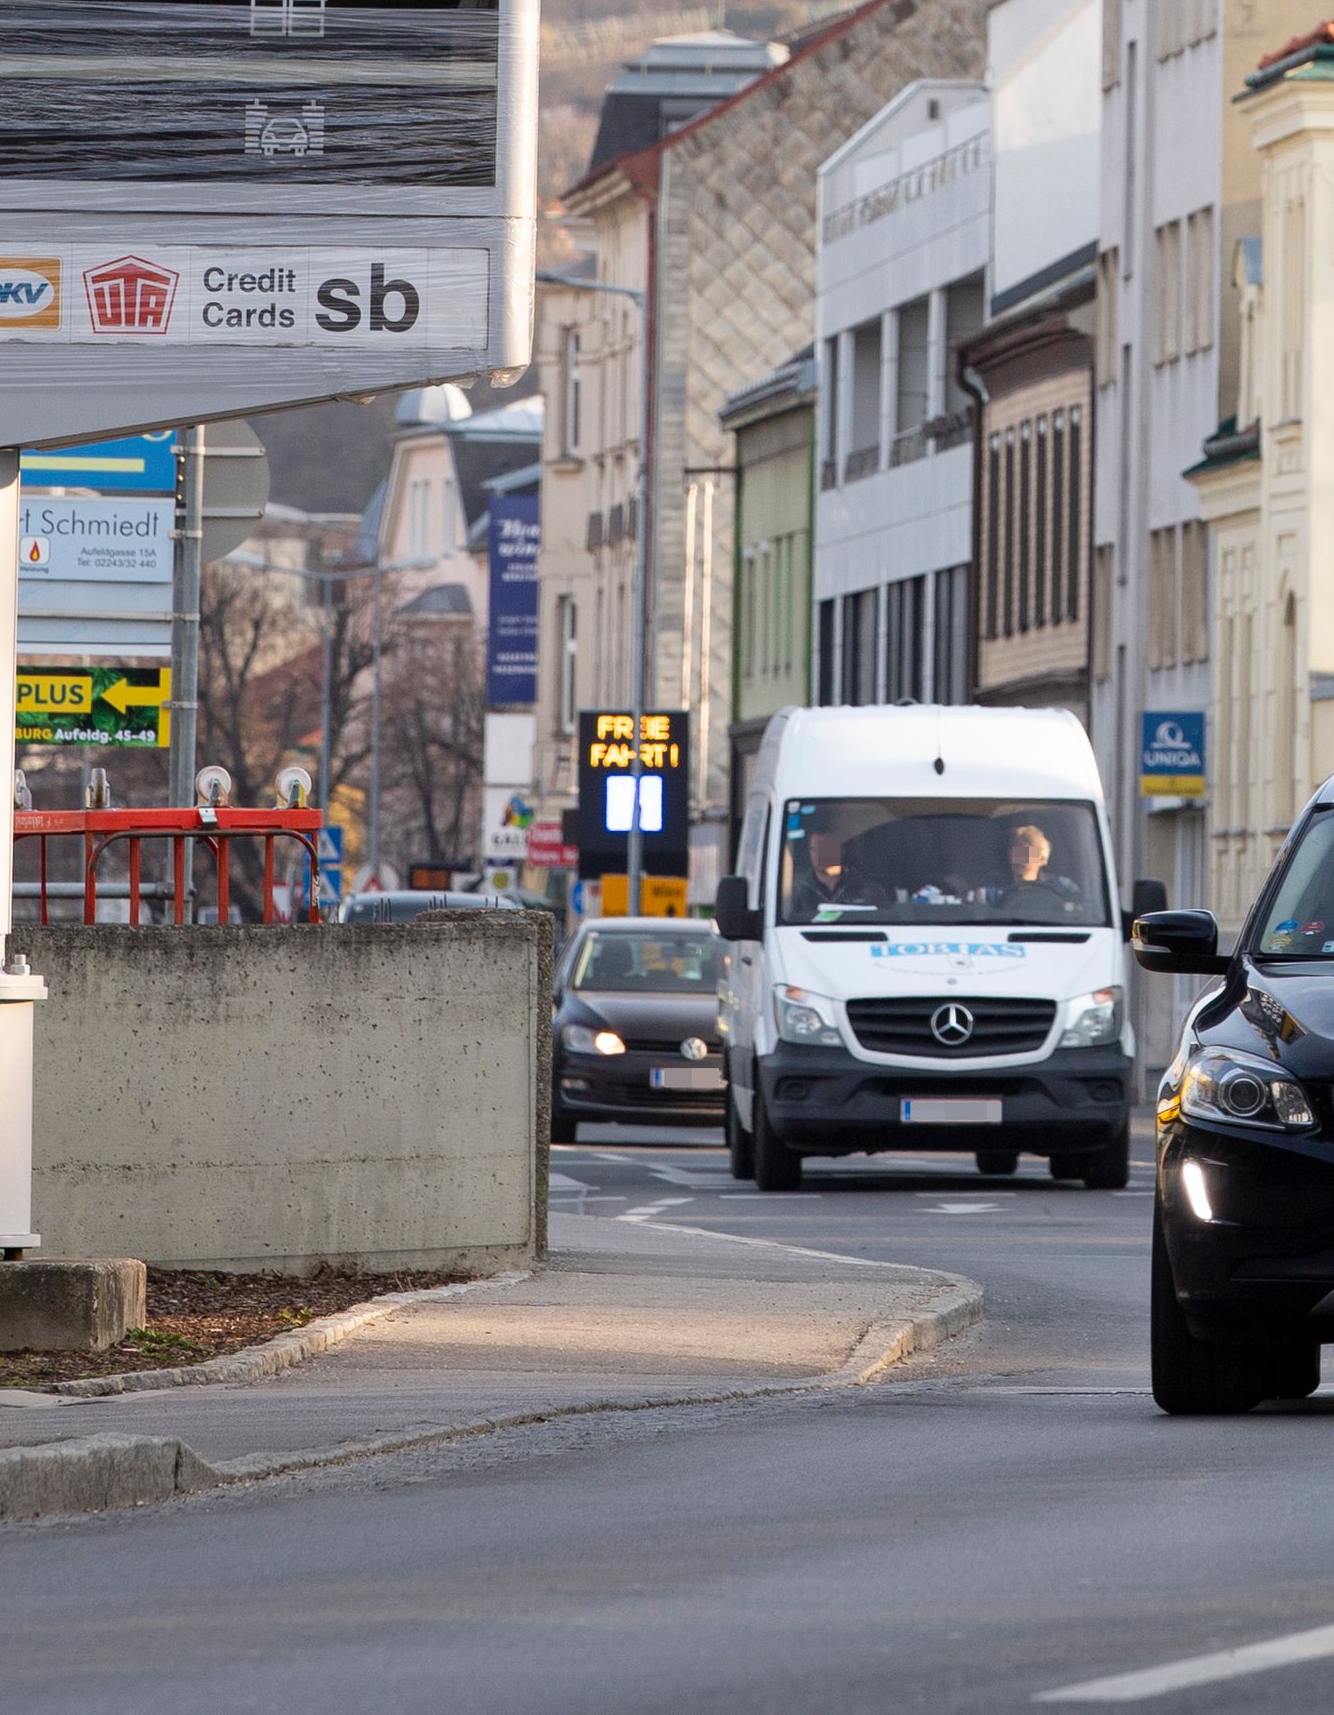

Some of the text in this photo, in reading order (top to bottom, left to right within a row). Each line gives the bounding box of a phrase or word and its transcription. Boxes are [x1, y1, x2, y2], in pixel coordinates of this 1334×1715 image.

[202, 266, 296, 294] Credit
[91, 263, 171, 327] UTA
[315, 263, 419, 333] sb
[202, 302, 296, 329] Cards
[41, 510, 159, 537] Schmiedt
[17, 684, 84, 704] PLUS
[55, 728, 113, 744] Aufeldg.
[1144, 751, 1201, 767] UNIQA
[871, 943, 1025, 957] TOBIAS
